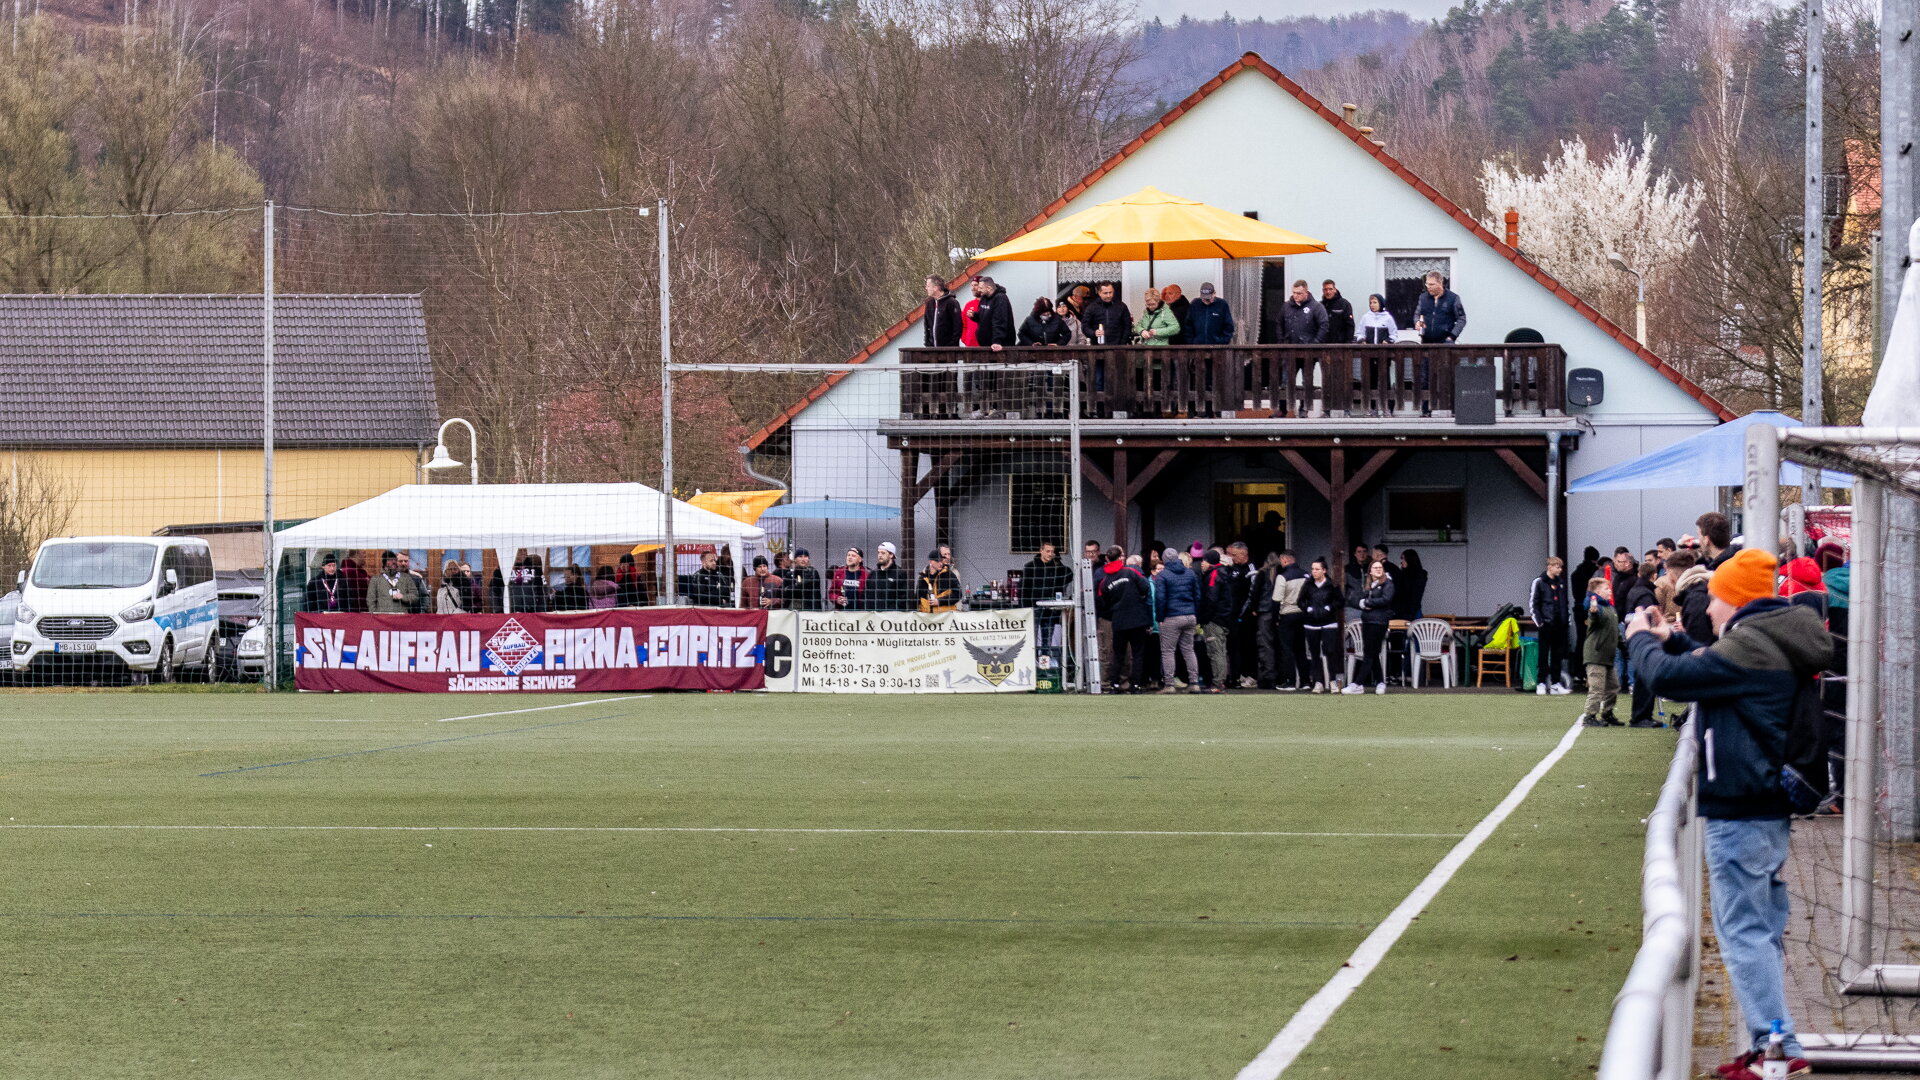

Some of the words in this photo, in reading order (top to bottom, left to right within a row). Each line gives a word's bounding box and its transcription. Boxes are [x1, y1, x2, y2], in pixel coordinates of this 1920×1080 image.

[802, 619, 860, 632] Tactical
[865, 620, 876, 632] &
[880, 619, 944, 632] Outdoor
[949, 617, 1027, 631] Ausstatter
[491, 637, 504, 646] SV
[503, 642, 526, 650] AUFBAU
[802, 637, 832, 646] 01809
[835, 637, 868, 646] Dohna
[877, 637, 941, 648] Müglitztalstr.
[944, 637, 956, 646] 55
[303, 628, 345, 669] SV
[356, 630, 480, 672] AUFBAU
[545, 626, 638, 670] PIRNA
[649, 625, 757, 668] COPITZ
[764, 633, 792, 679] e
[802, 649, 855, 660] Geöffnet:
[802, 663, 820, 673] Mo
[823, 664, 889, 674] 15:30-17:30
[448, 674, 520, 691] SÄCHSISCHE
[522, 674, 576, 690] SCHWEIZ
[802, 677, 815, 687] Mi
[820, 677, 850, 687] 14-18
[861, 678, 876, 688] Sa
[879, 678, 921, 688] 9:30-13
